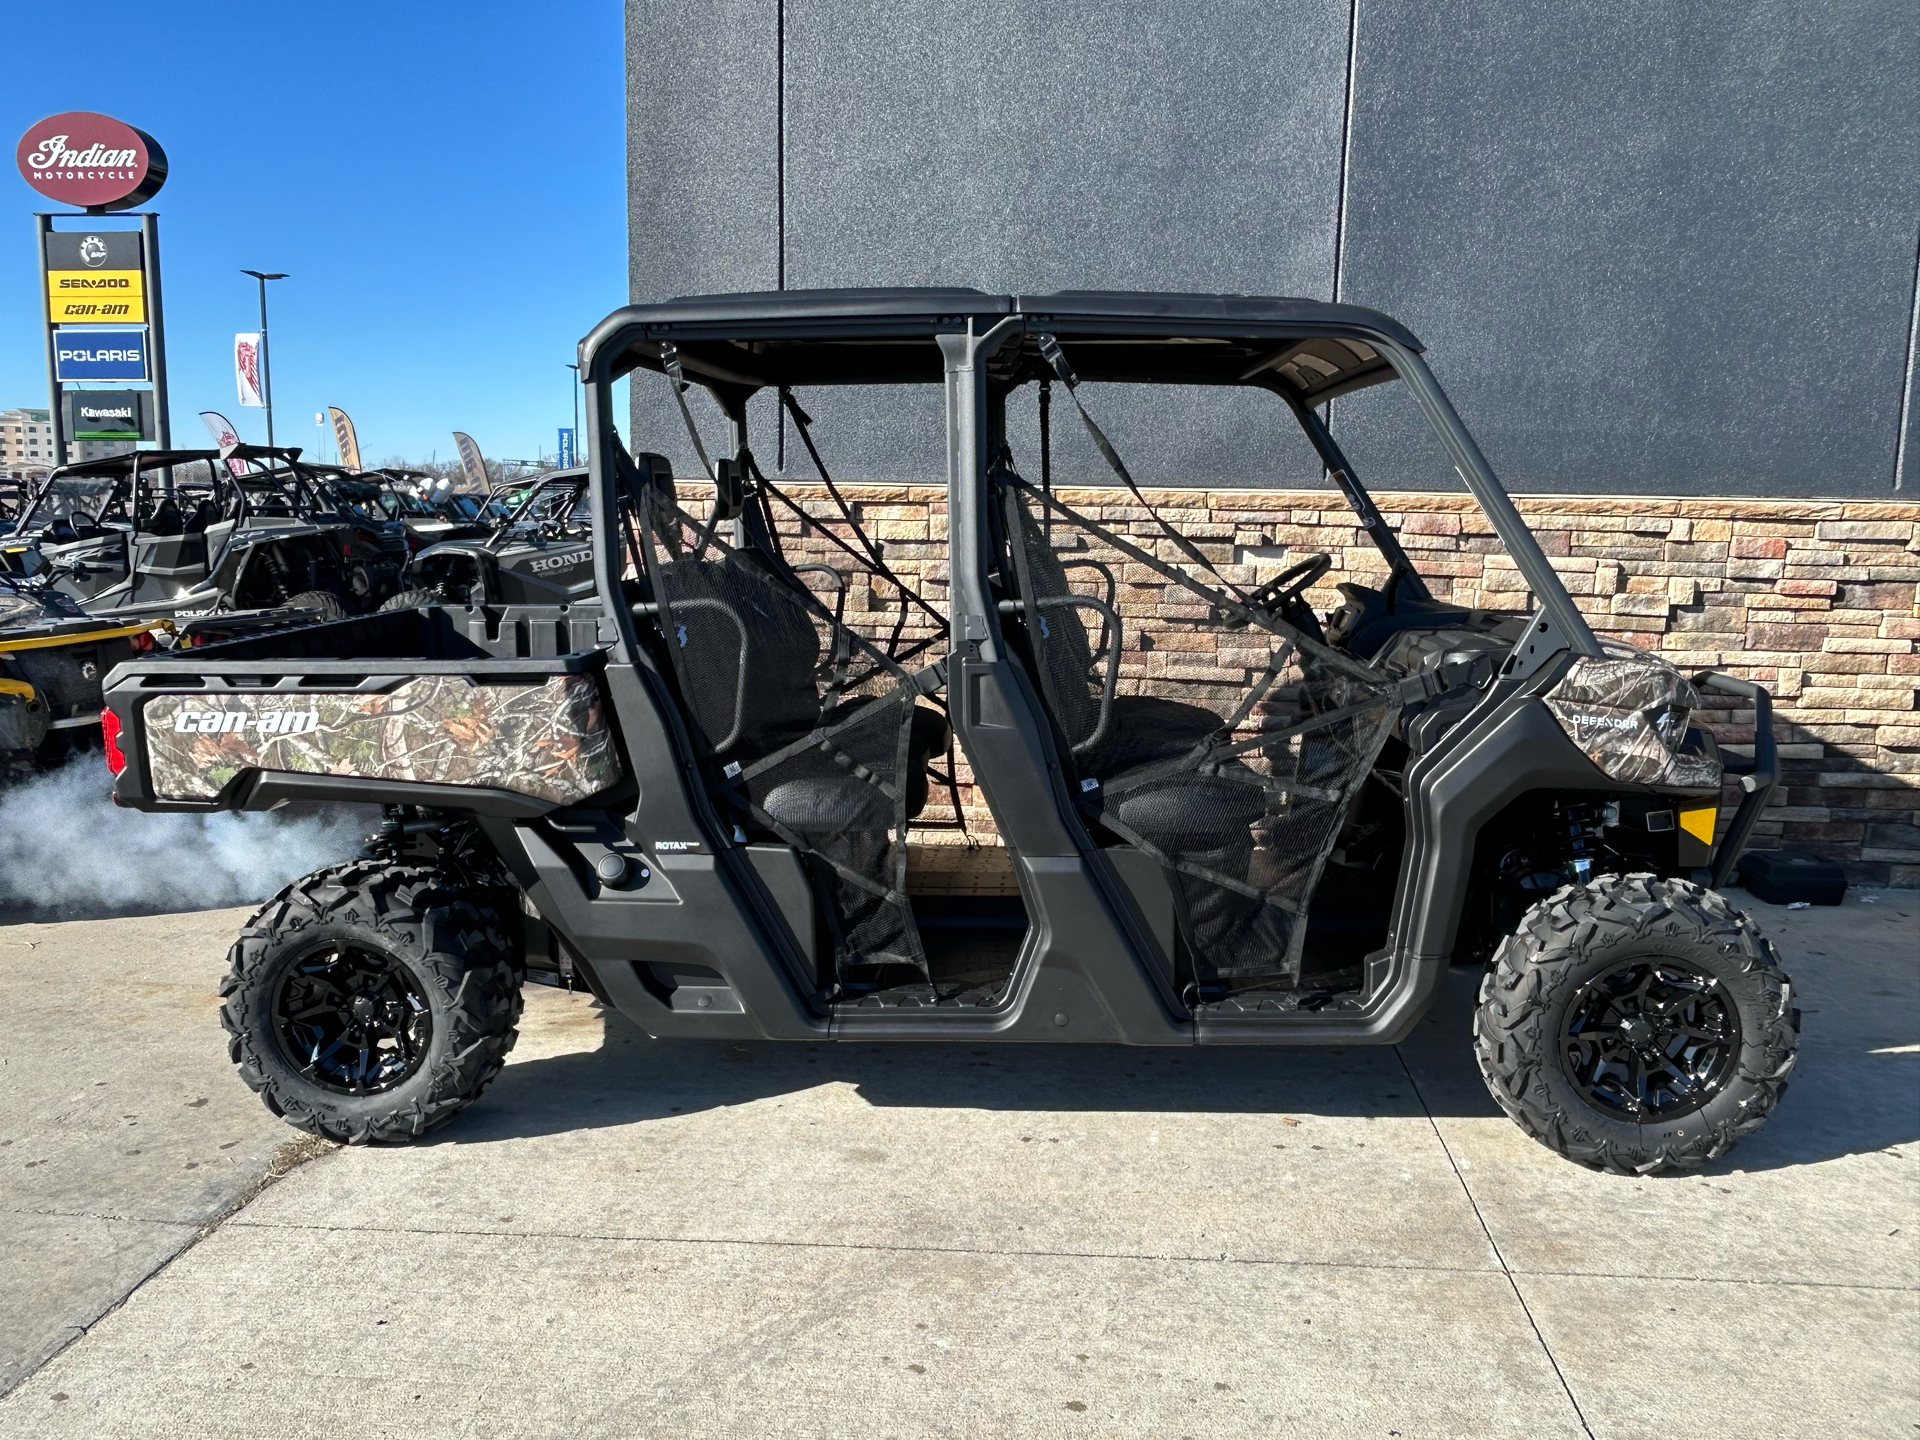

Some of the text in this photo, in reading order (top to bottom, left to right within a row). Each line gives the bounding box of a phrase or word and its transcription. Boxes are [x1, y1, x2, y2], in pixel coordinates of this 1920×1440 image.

[28, 135, 136, 169] Indian
[33, 171, 135, 180] MOTORCYCLE
[64, 304, 130, 315] can-am
[60, 350, 140, 361] POLARIS
[81, 407, 132, 418] Kawasaki
[529, 550, 593, 573] HOND
[174, 609, 223, 618] POLARS
[174, 711, 320, 733] can-am
[1572, 714, 1639, 730] DEFENDER
[655, 841, 688, 850] ROTAX
